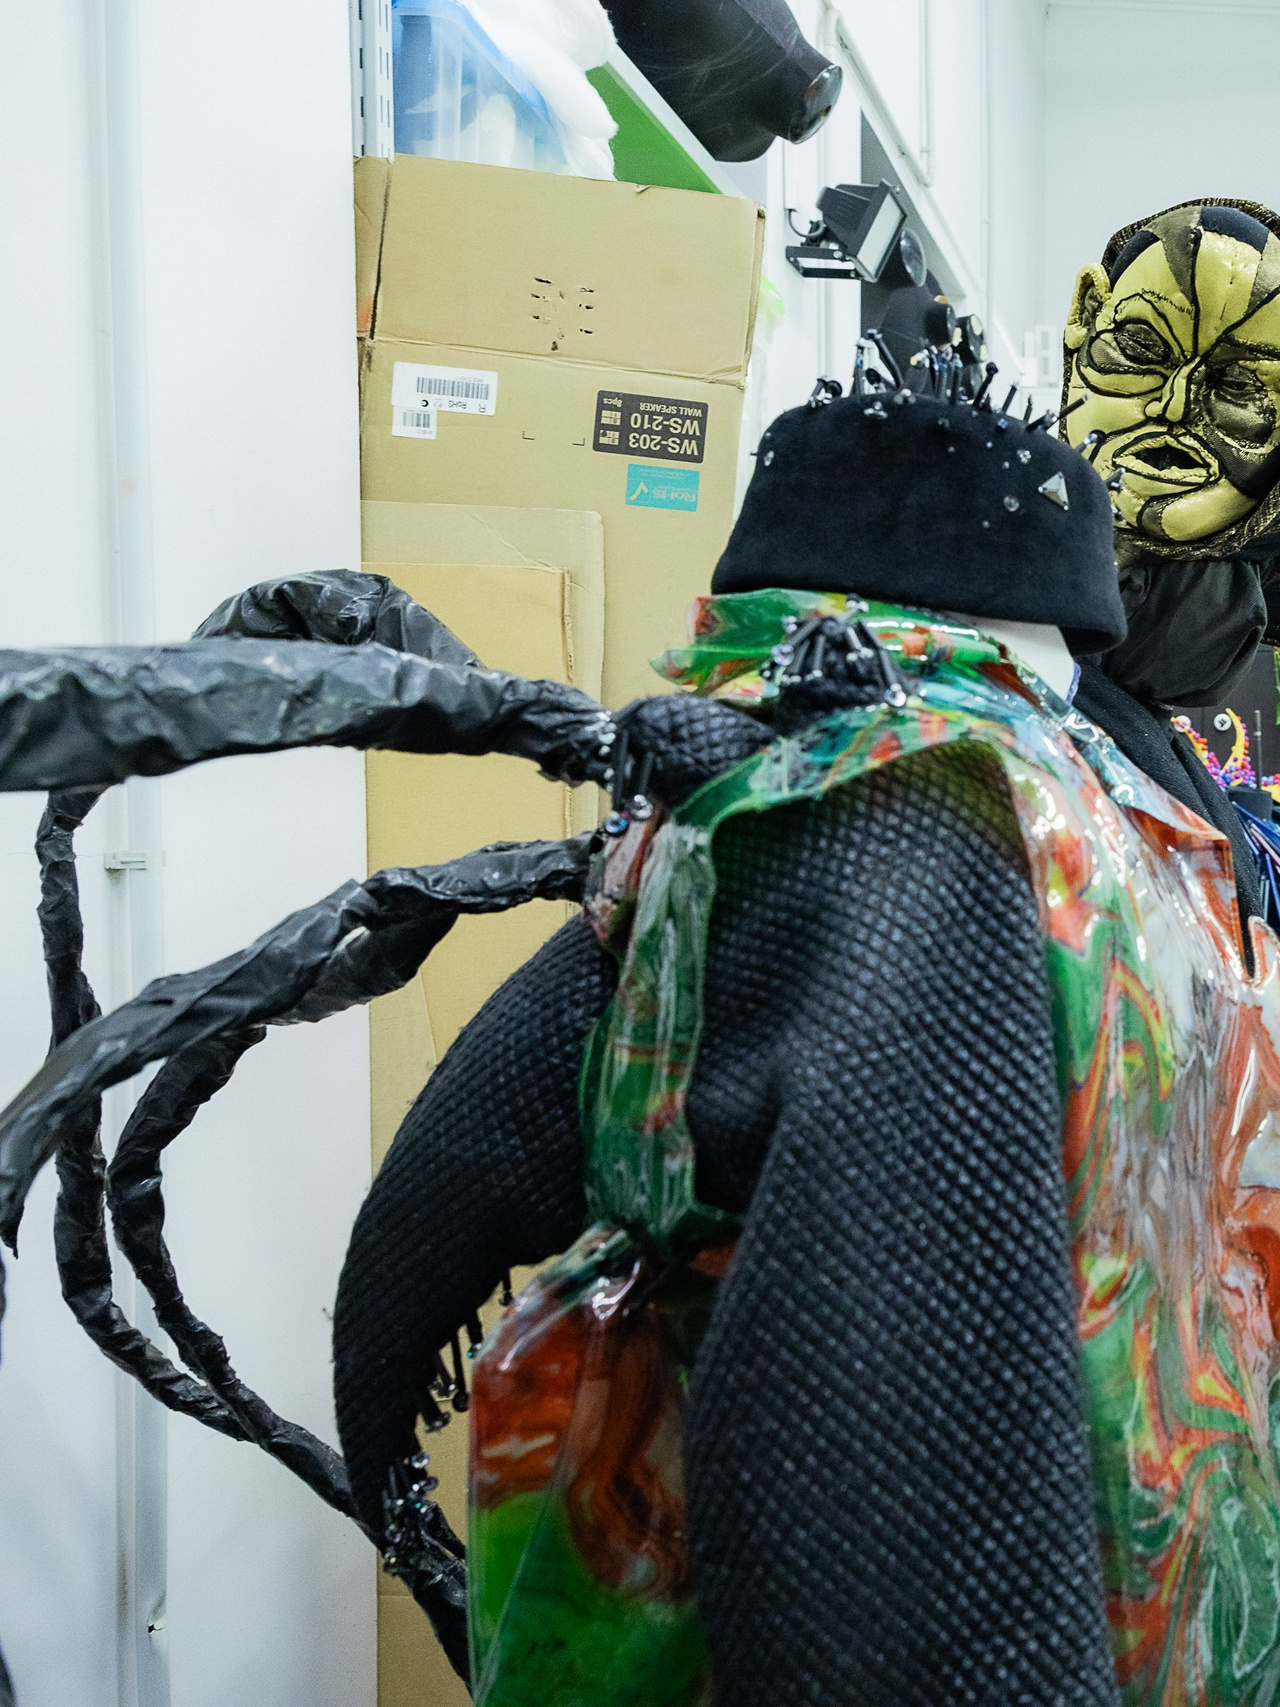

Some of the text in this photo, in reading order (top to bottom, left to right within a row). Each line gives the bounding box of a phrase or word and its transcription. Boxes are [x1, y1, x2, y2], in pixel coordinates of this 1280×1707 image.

[603, 397, 622, 407] 8pcs
[639, 402, 702, 417] WALL SPEAKER
[630, 413, 700, 436] WS-210
[628, 432, 699, 456] WS-203
